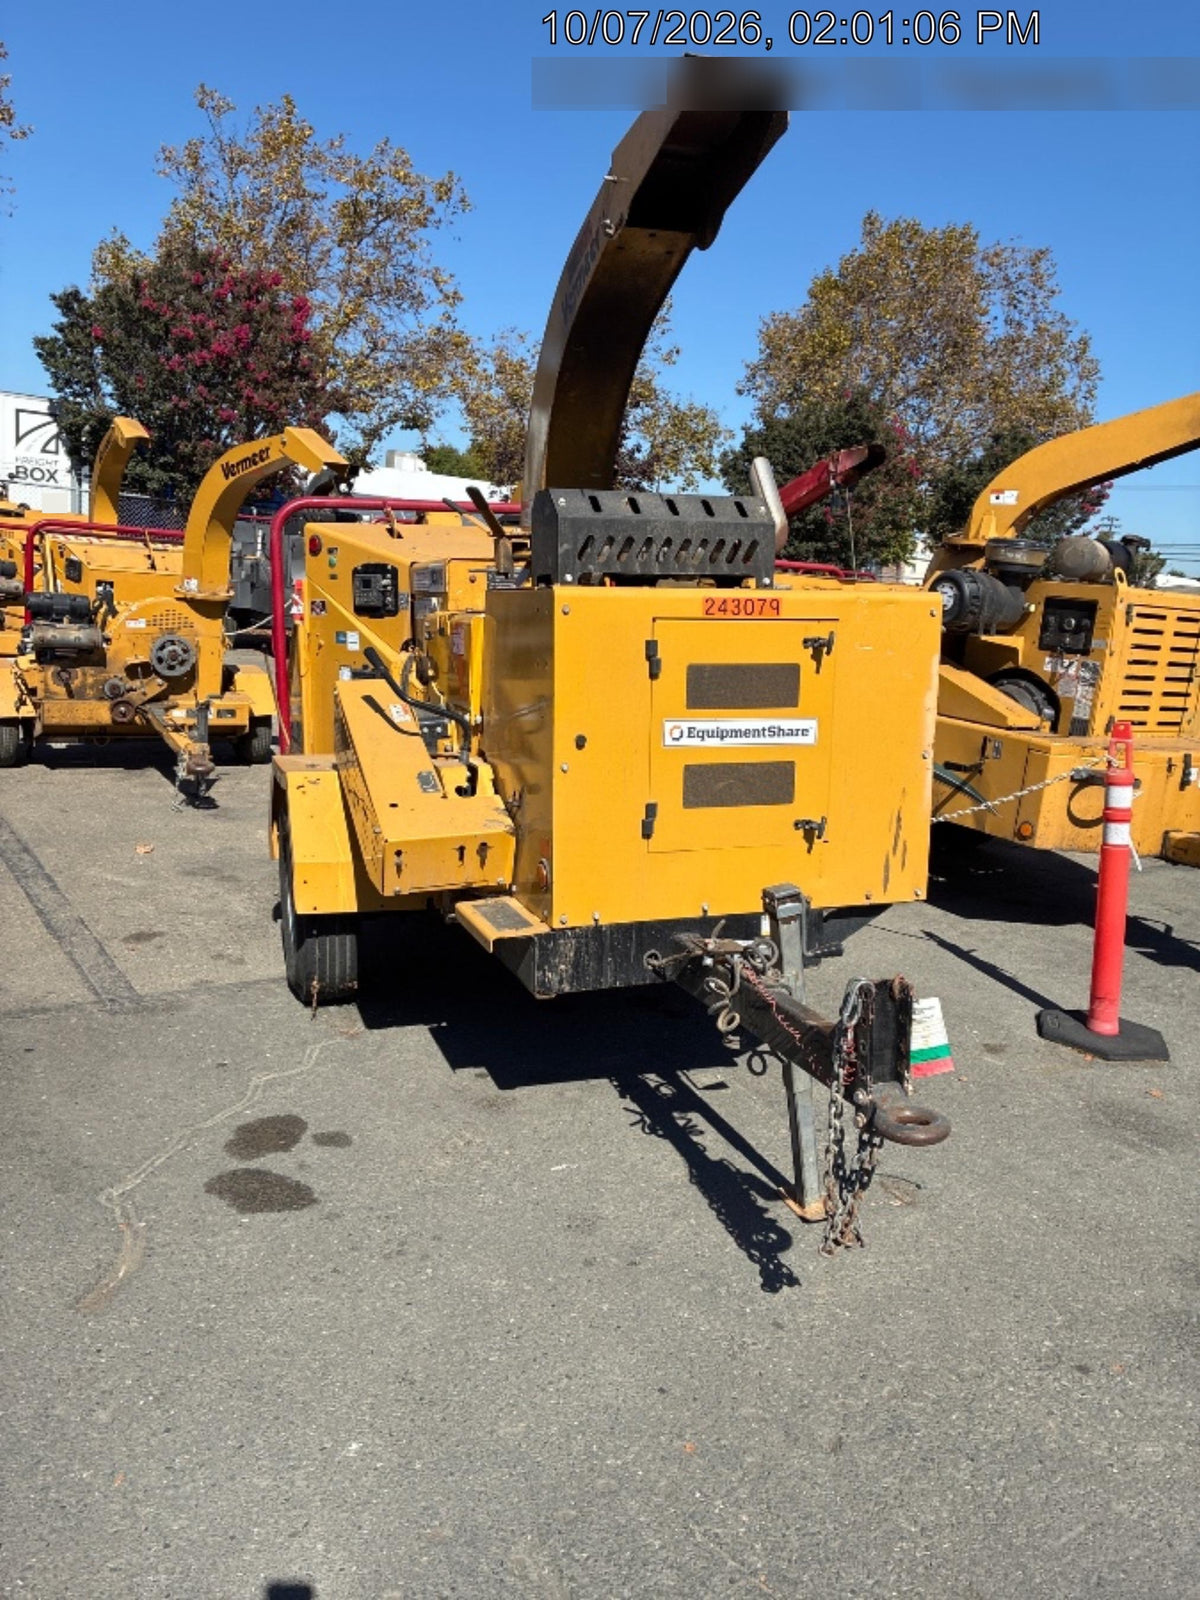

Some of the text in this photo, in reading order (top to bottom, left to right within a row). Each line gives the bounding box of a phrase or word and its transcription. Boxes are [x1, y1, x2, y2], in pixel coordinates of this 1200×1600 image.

[221, 446, 271, 480] Vermeer
[15, 465, 59, 484] BOX
[704, 597, 781, 616] 243079
[687, 725, 810, 741] EquipmentShare
